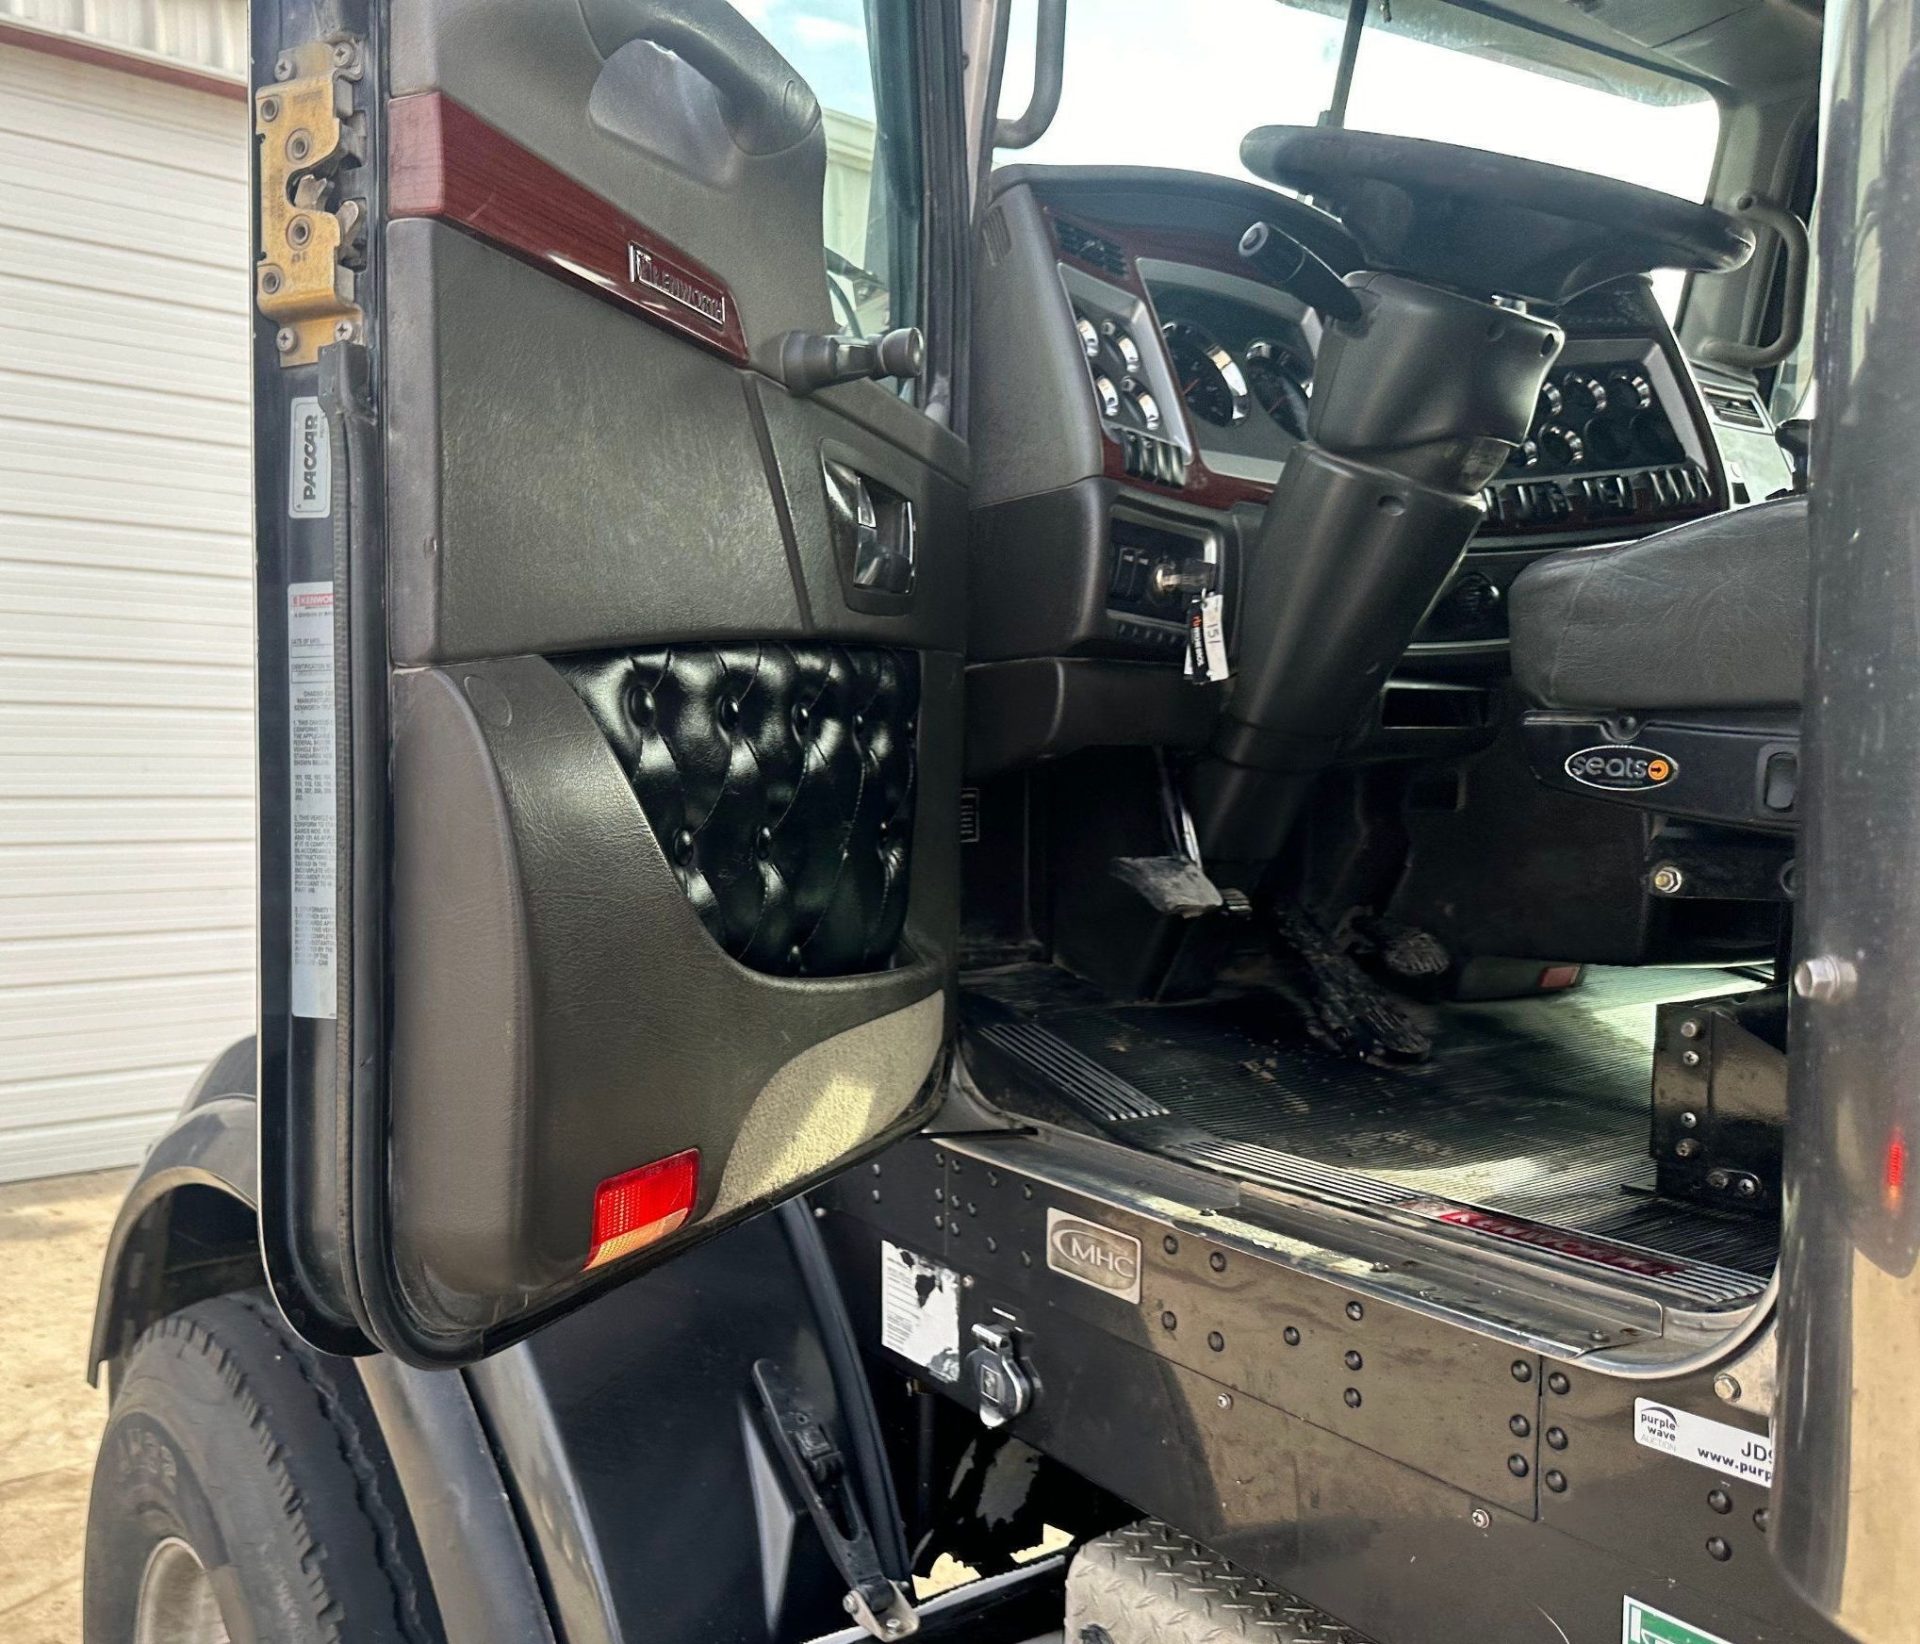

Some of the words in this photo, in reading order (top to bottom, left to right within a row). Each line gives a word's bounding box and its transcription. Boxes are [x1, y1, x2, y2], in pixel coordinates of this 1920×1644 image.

[303, 414, 318, 500] PACCAR
[1572, 756, 1648, 778] seats
[1071, 1236, 1135, 1278] MHC
[1641, 1413, 1676, 1431] purple
[1647, 1425, 1676, 1442] wave
